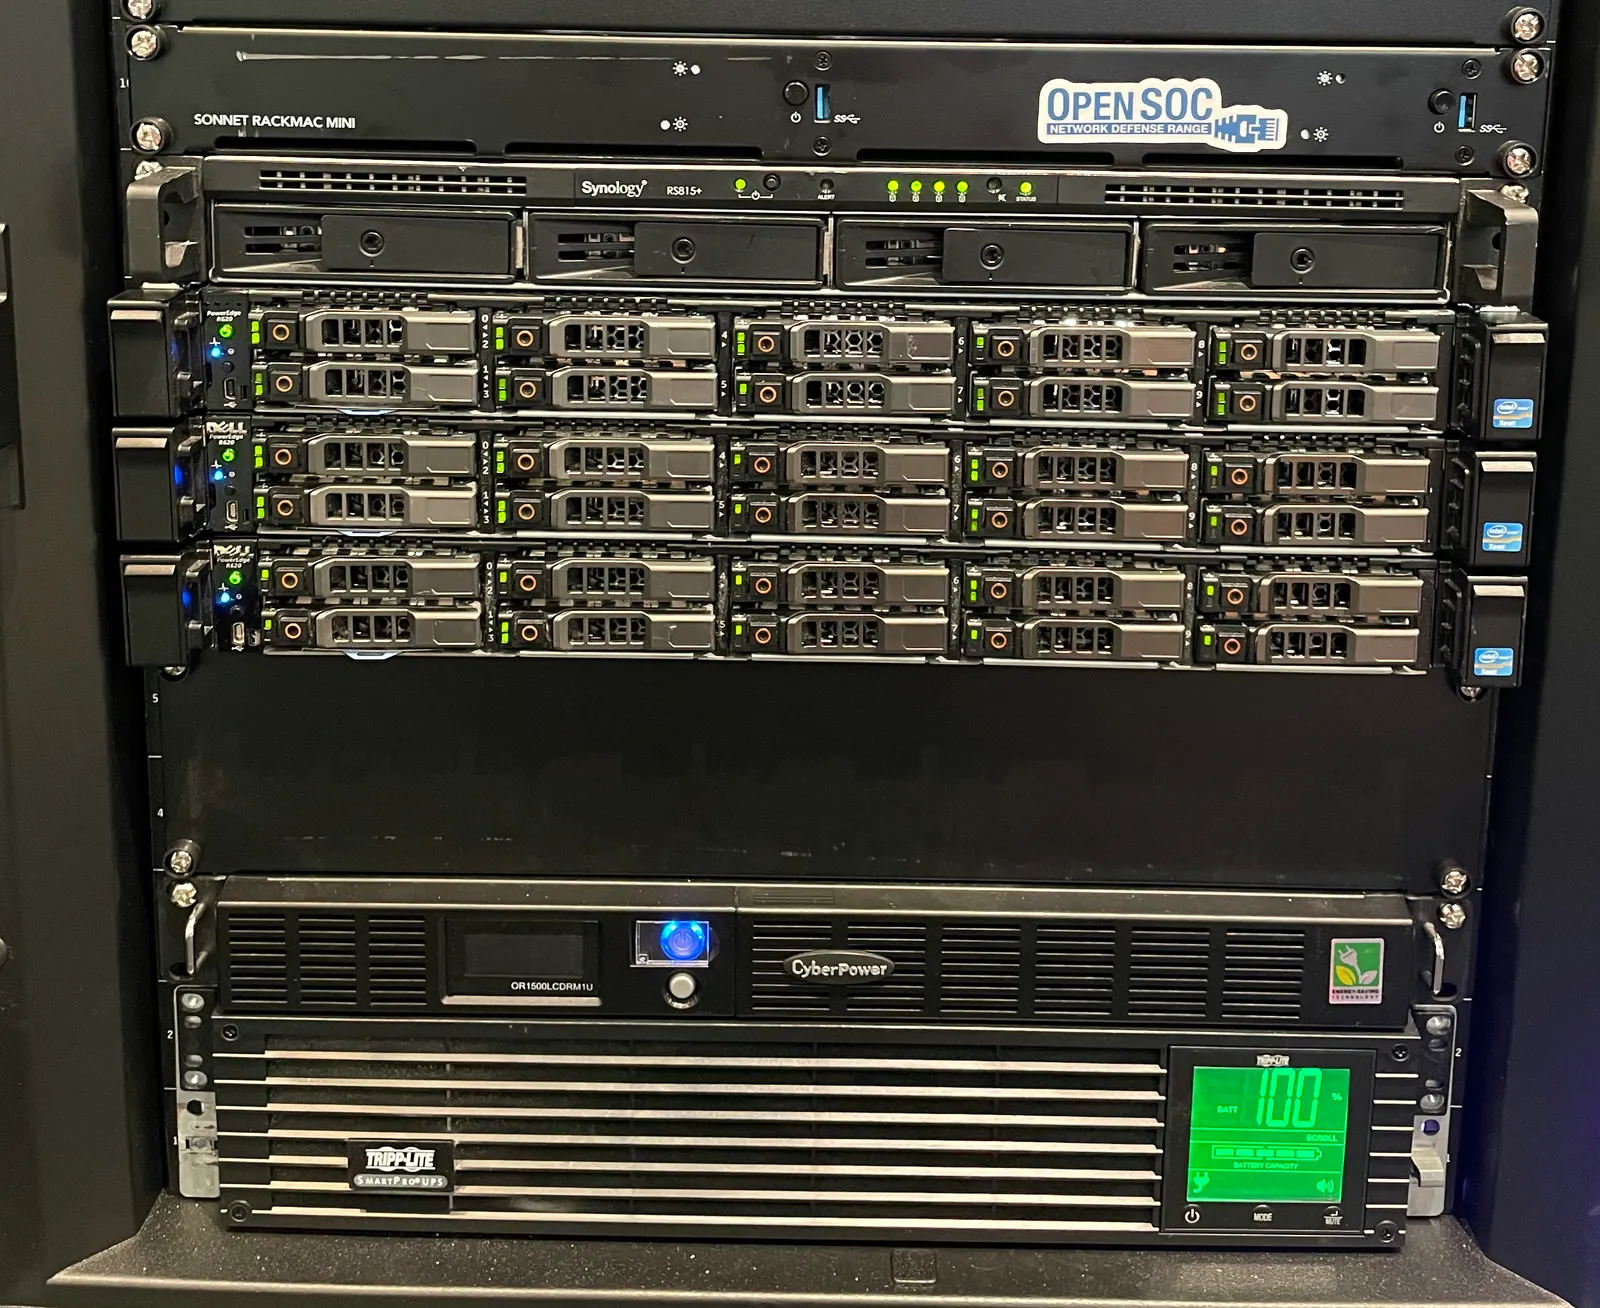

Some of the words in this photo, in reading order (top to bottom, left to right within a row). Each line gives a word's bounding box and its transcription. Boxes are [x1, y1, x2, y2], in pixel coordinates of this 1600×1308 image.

[193, 113, 249, 127] SONNET
[252, 114, 323, 129] RACKMAC
[326, 116, 356, 129] MINI
[1050, 124, 1108, 135] NETWORK
[1111, 123, 1164, 135] DEFENSE
[1167, 124, 1209, 135] RANGE
[581, 179, 648, 198] Synology
[666, 185, 703, 196] RS815+
[481, 314, 489, 323] 0
[721, 331, 729, 339] 4
[482, 340, 489, 349] 2
[958, 337, 965, 345] 6
[1198, 340, 1206, 349] 8
[482, 365, 489, 374] 1
[721, 380, 728, 389] 5
[483, 390, 490, 398] 3
[957, 386, 964, 395] 7
[1196, 391, 1204, 399] 9
[482, 441, 489, 450] 0
[719, 452, 726, 460] 4
[954, 455, 961, 464] 6
[482, 466, 489, 475] 2
[1191, 463, 1198, 472] 8
[483, 491, 489, 499] 1
[953, 504, 960, 513] 7
[483, 515, 490, 524] 3
[1188, 512, 1196, 521] 9
[486, 562, 493, 570] 0
[953, 576, 960, 585] 6
[1187, 582, 1194, 591] 8
[487, 610, 494, 619] 1
[951, 624, 959, 632] 7
[487, 633, 495, 642] 3
[1185, 630, 1192, 639] 9
[152, 693, 159, 703] 5
[157, 808, 164, 817] 4
[792, 959, 888, 979] CyberPower
[510, 981, 594, 992] OR1500LCDRM1U
[167, 1030, 174, 1039] 2
[1455, 1048, 1463, 1057] 2
[1217, 1106, 1239, 1114] BATT
[1256, 1068, 1323, 1128] 100
[1306, 1134, 1338, 1142] SCROLL
[1233, 1161, 1264, 1170] BATTERY
[1265, 1162, 1299, 1170] CAPACITY
[1253, 1212, 1273, 1222] MODE
